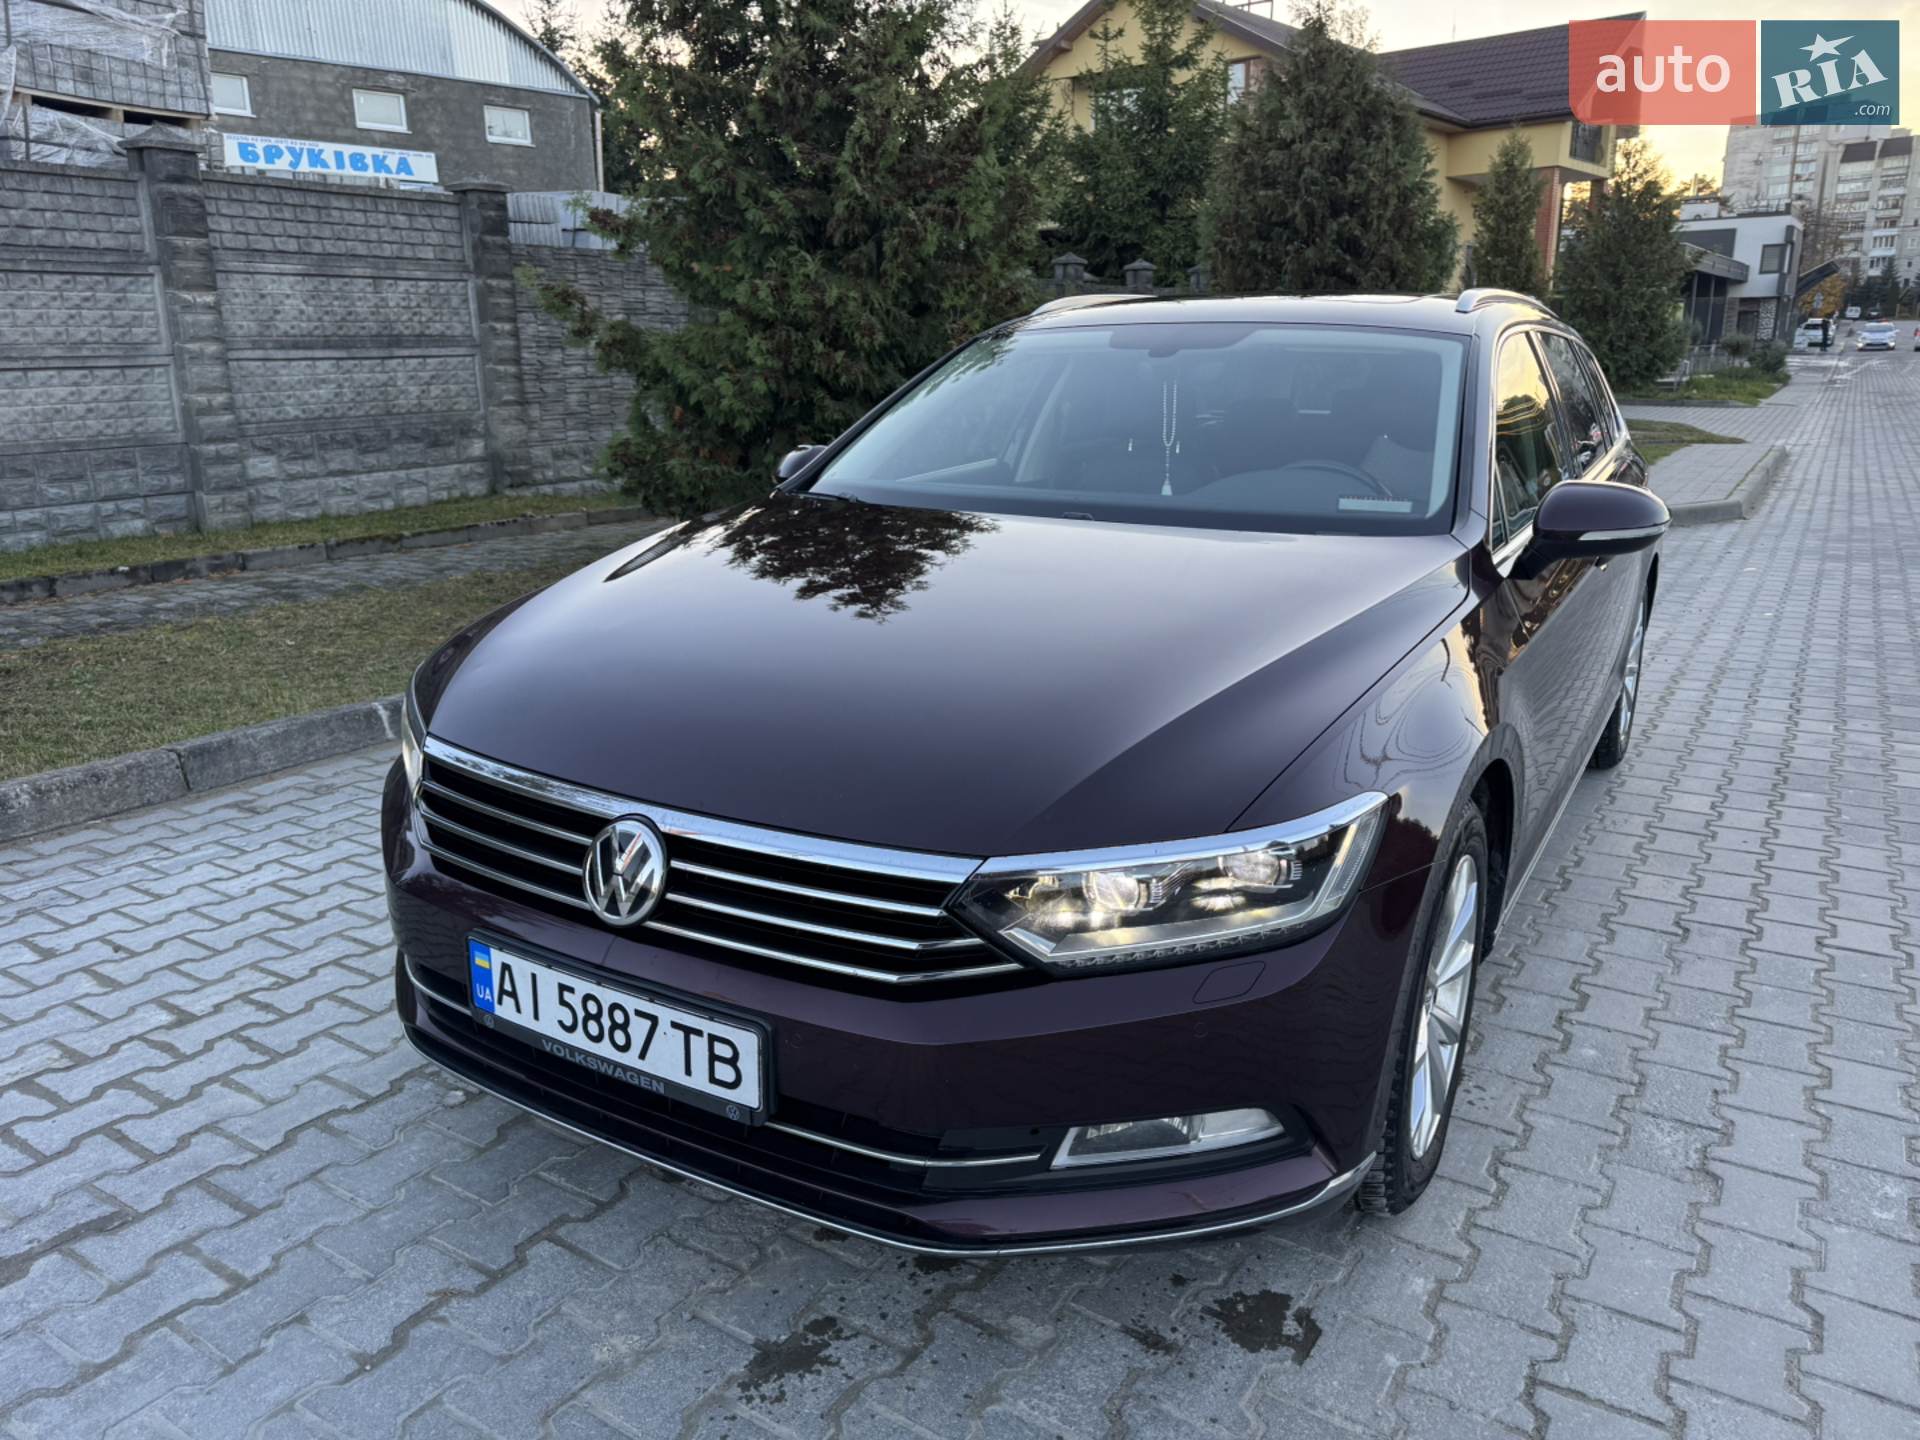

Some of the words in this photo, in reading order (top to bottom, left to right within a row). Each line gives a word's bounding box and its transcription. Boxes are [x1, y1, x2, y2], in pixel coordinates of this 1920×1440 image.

[237, 142, 415, 176] БРУКІВКА
[476, 983, 493, 1003] UA
[497, 961, 539, 1022] AI
[556, 981, 659, 1061] 5887
[670, 1020, 743, 1091] TB
[540, 1038, 666, 1095] VOLKSWAGEN
